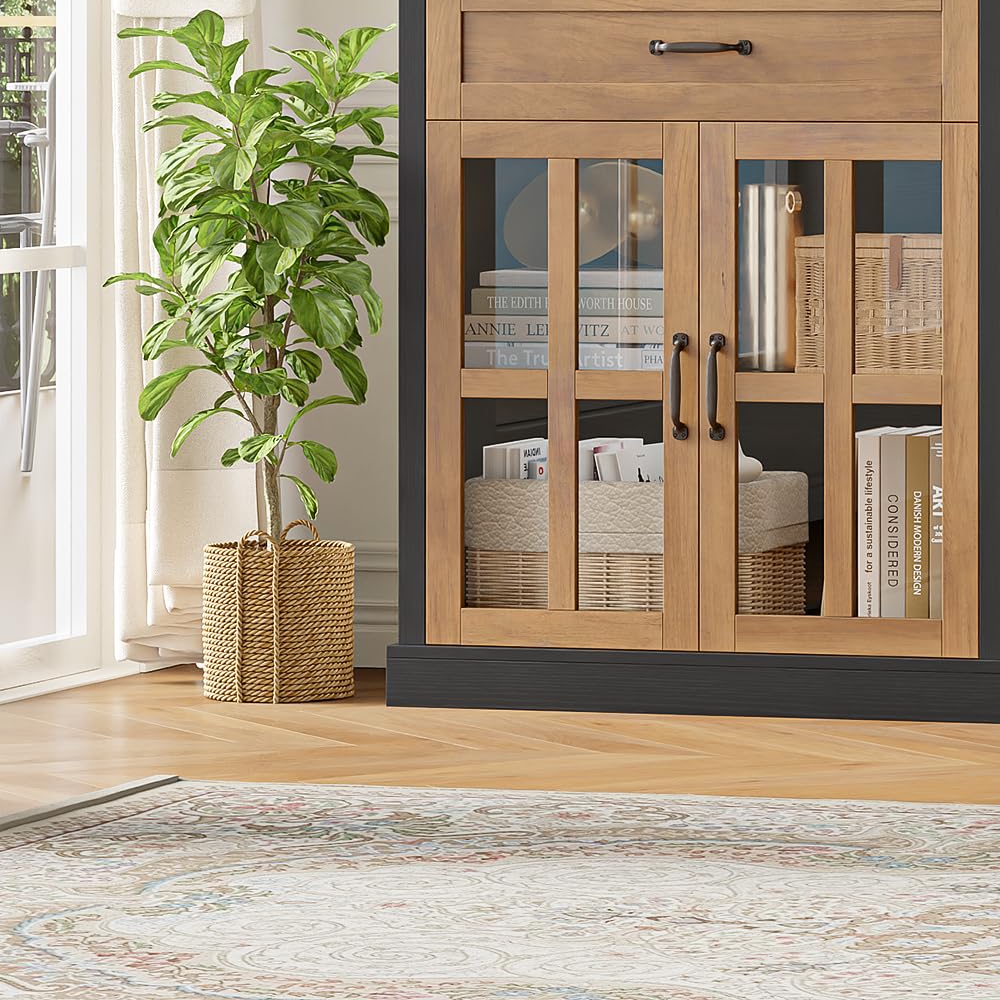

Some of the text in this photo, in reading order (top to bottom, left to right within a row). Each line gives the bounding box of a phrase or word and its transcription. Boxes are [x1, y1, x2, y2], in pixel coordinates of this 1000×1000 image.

[486, 296, 508, 309] THE
[511, 296, 542, 309] EDITH
[618, 298, 653, 311] HOUSE
[464, 323, 639, 336] ANNIE AT
[486, 350, 518, 366] The
[864, 460, 874, 496] lifestyle
[864, 498, 873, 550] sustainable
[887, 494, 899, 588] CONSIDERED
[912, 491, 922, 596] DANISH MODERN DESIGN
[864, 560, 873, 573] for
